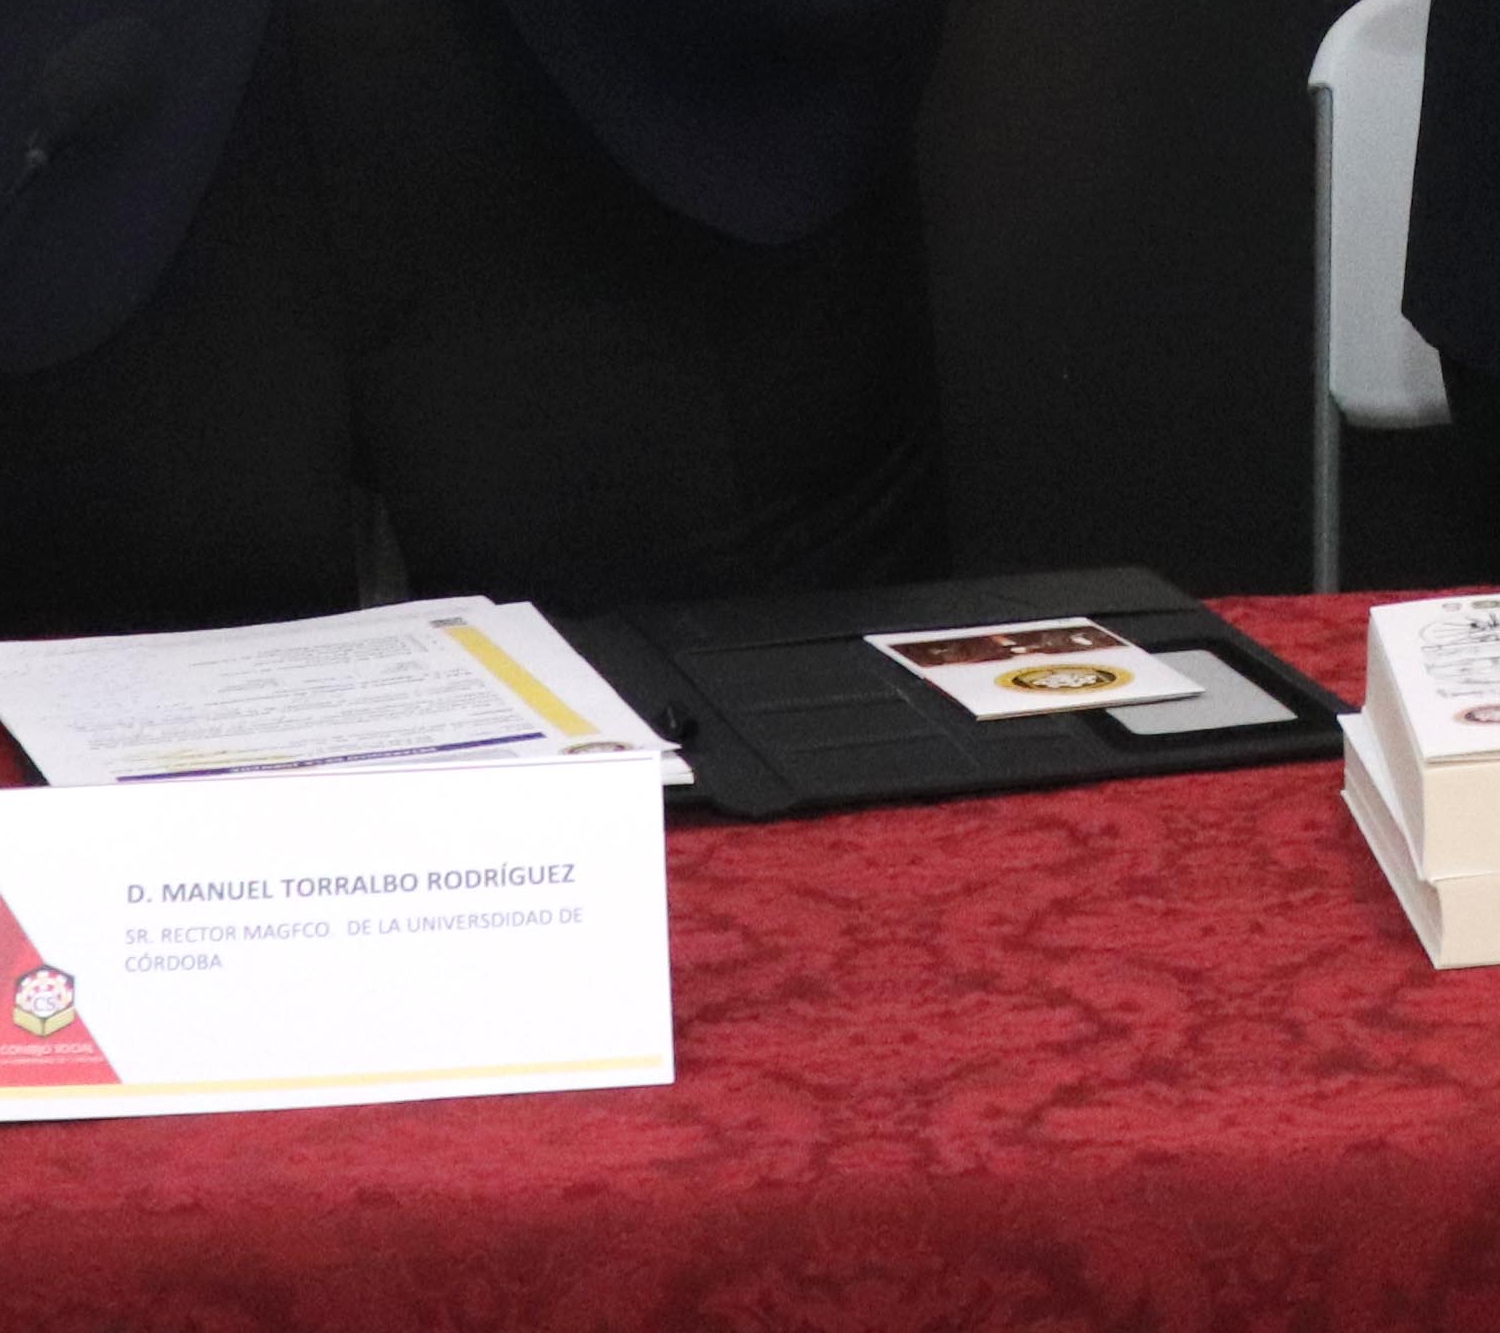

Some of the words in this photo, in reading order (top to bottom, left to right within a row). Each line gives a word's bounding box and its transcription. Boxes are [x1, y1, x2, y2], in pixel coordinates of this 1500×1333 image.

[126, 884, 153, 905] D.
[162, 880, 274, 903] MANUEL
[282, 872, 419, 899] TORRALBO
[427, 863, 576, 891] RODRÍGUEZ
[125, 928, 153, 946] SR.
[161, 925, 238, 944] RECTOR
[347, 919, 373, 937] DE
[378, 918, 401, 935] LA
[407, 909, 553, 933] UNIVERSDIDAD
[559, 906, 584, 925] DE
[125, 951, 223, 974] CÓRDOBA
